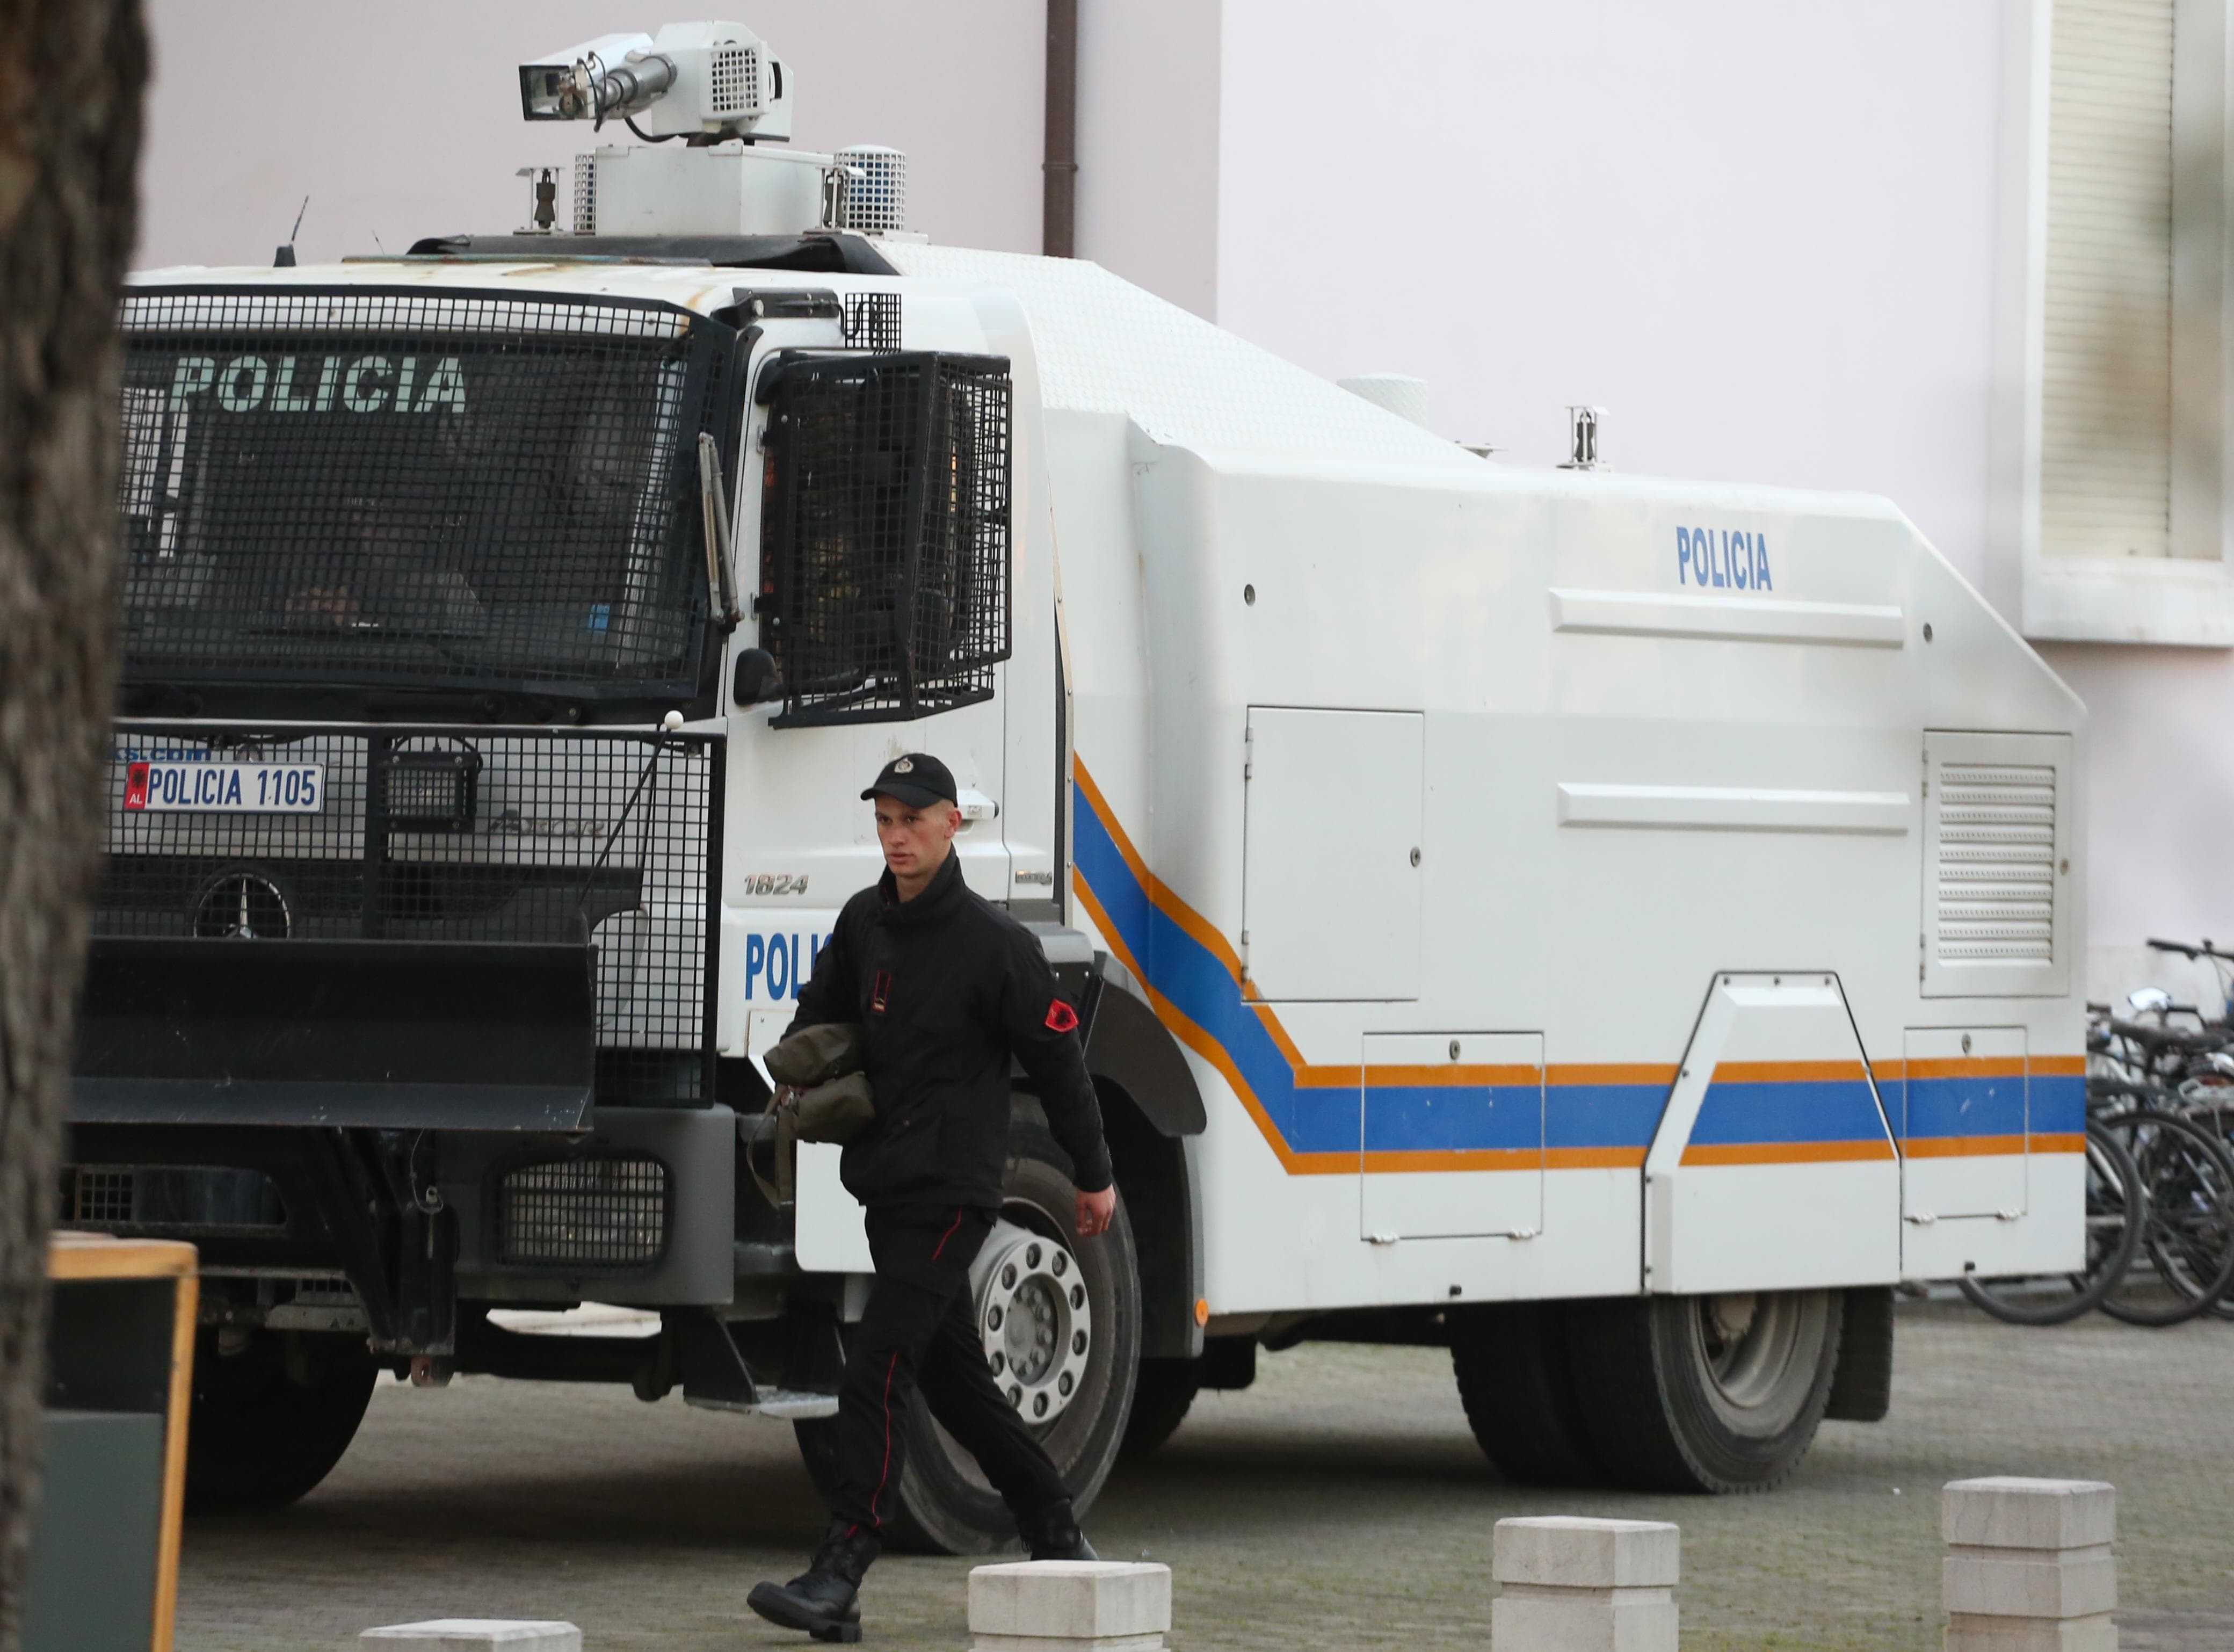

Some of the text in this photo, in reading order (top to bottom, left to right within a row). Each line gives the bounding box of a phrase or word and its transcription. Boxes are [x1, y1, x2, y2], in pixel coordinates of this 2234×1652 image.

[168, 354, 467, 414] POLICIA
[1676, 525, 1773, 591] POLICIA
[129, 793, 143, 805] AL
[147, 768, 316, 806] POLICIA 1105
[744, 873, 809, 896] 1824
[745, 932, 834, 1001] POLI
